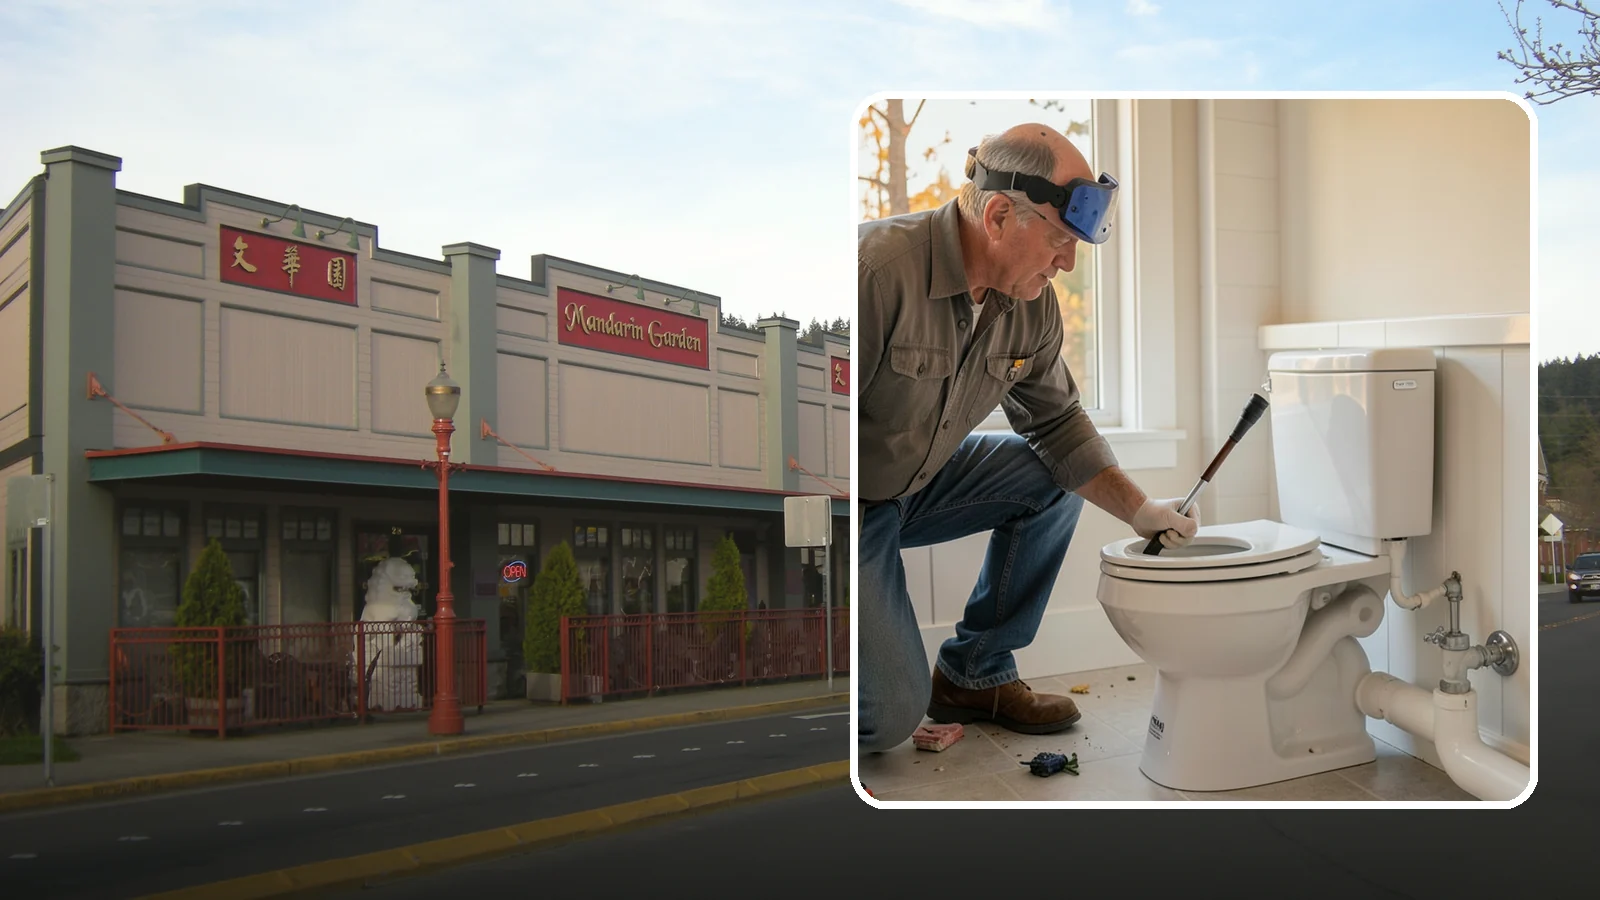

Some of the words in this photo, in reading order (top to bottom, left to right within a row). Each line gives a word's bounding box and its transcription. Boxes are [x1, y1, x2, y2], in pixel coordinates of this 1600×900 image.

[564, 302, 644, 341] Mandarin
[647, 320, 702, 352] Garden
[503, 565, 527, 578] OPEN
